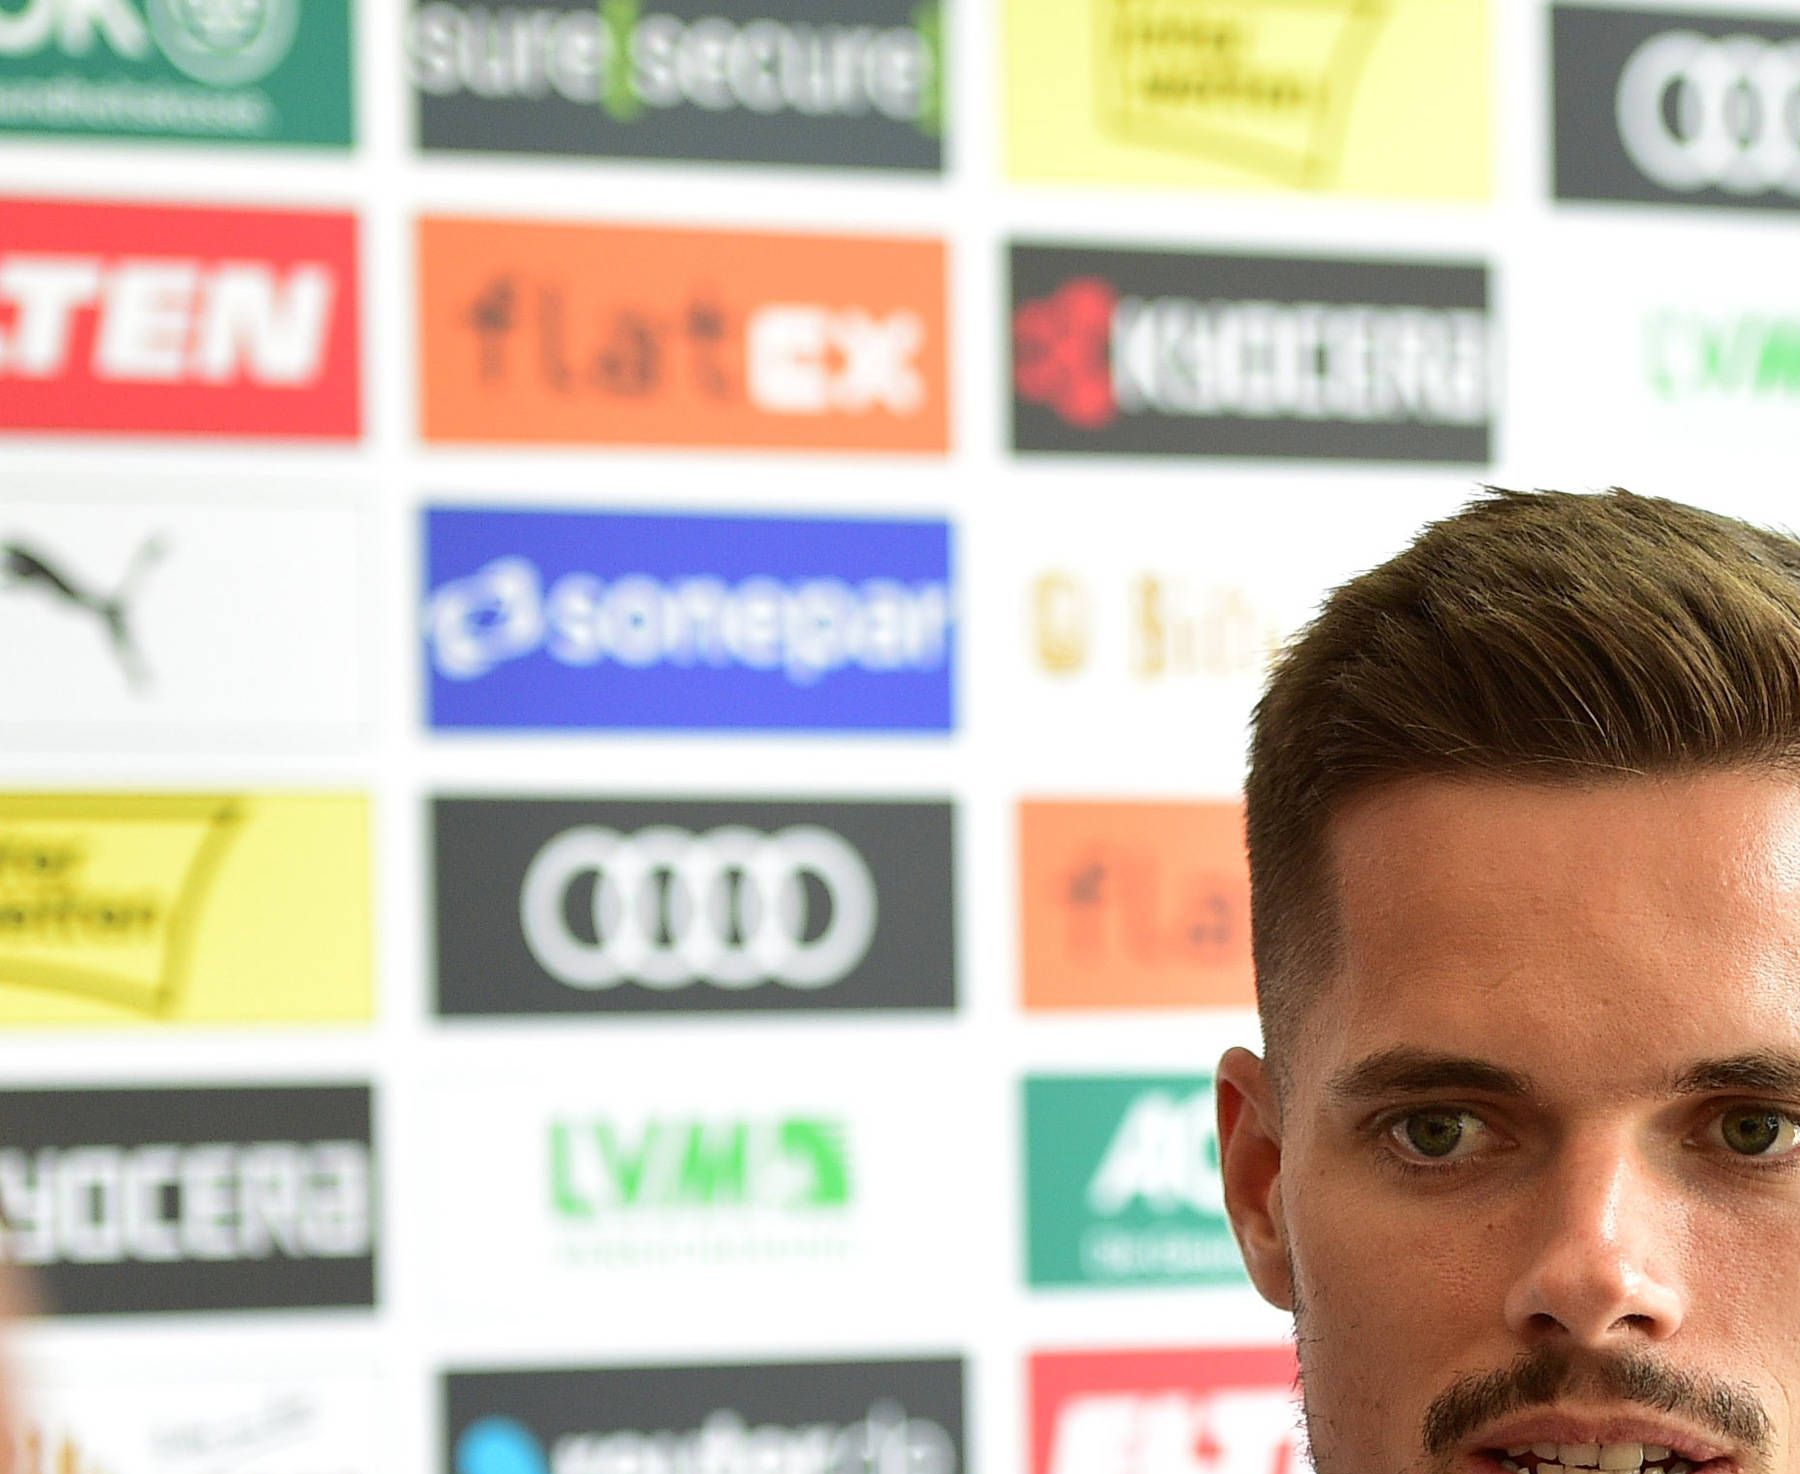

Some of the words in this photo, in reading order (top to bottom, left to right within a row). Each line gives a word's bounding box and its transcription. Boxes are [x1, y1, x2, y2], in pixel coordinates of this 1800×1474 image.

[1114, 296, 1489, 426] KYOCERA
[543, 570, 950, 690] sonepar
[548, 1115, 752, 1218] LVM
